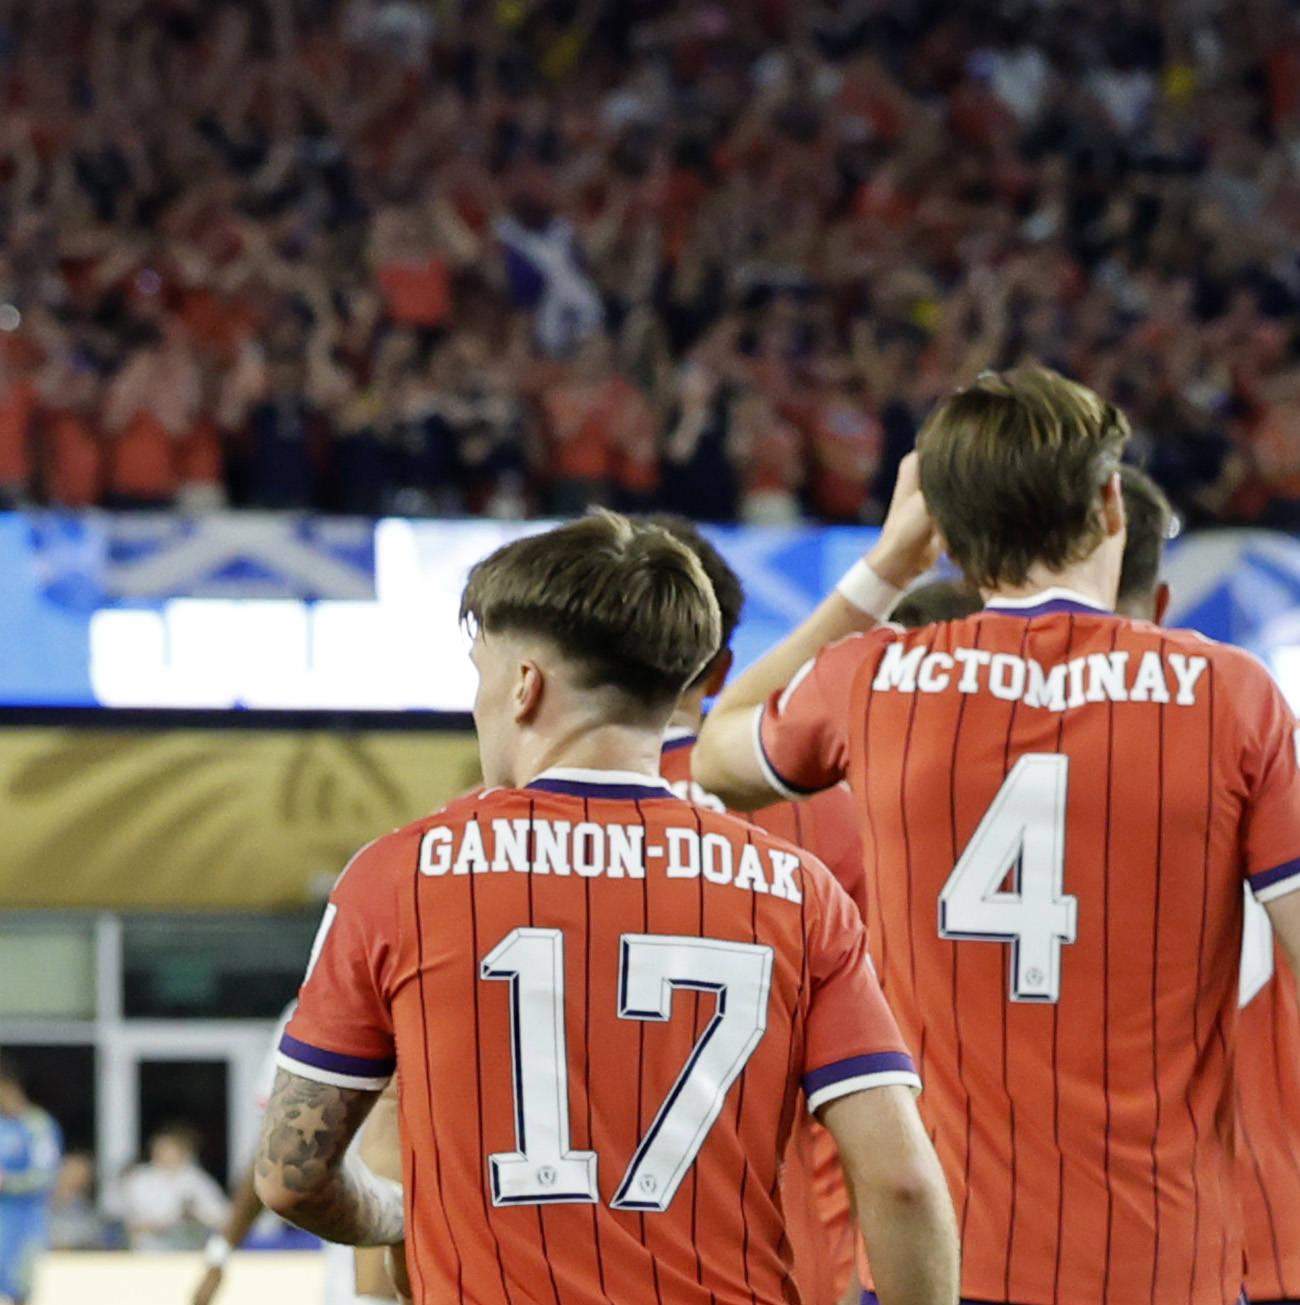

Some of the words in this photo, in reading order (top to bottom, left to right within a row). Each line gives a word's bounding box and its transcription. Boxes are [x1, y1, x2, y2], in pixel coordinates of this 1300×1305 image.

[419, 818, 803, 904] GANNON-DOAK
[937, 752, 1078, 1004] 4
[480, 927, 775, 1212] 17
